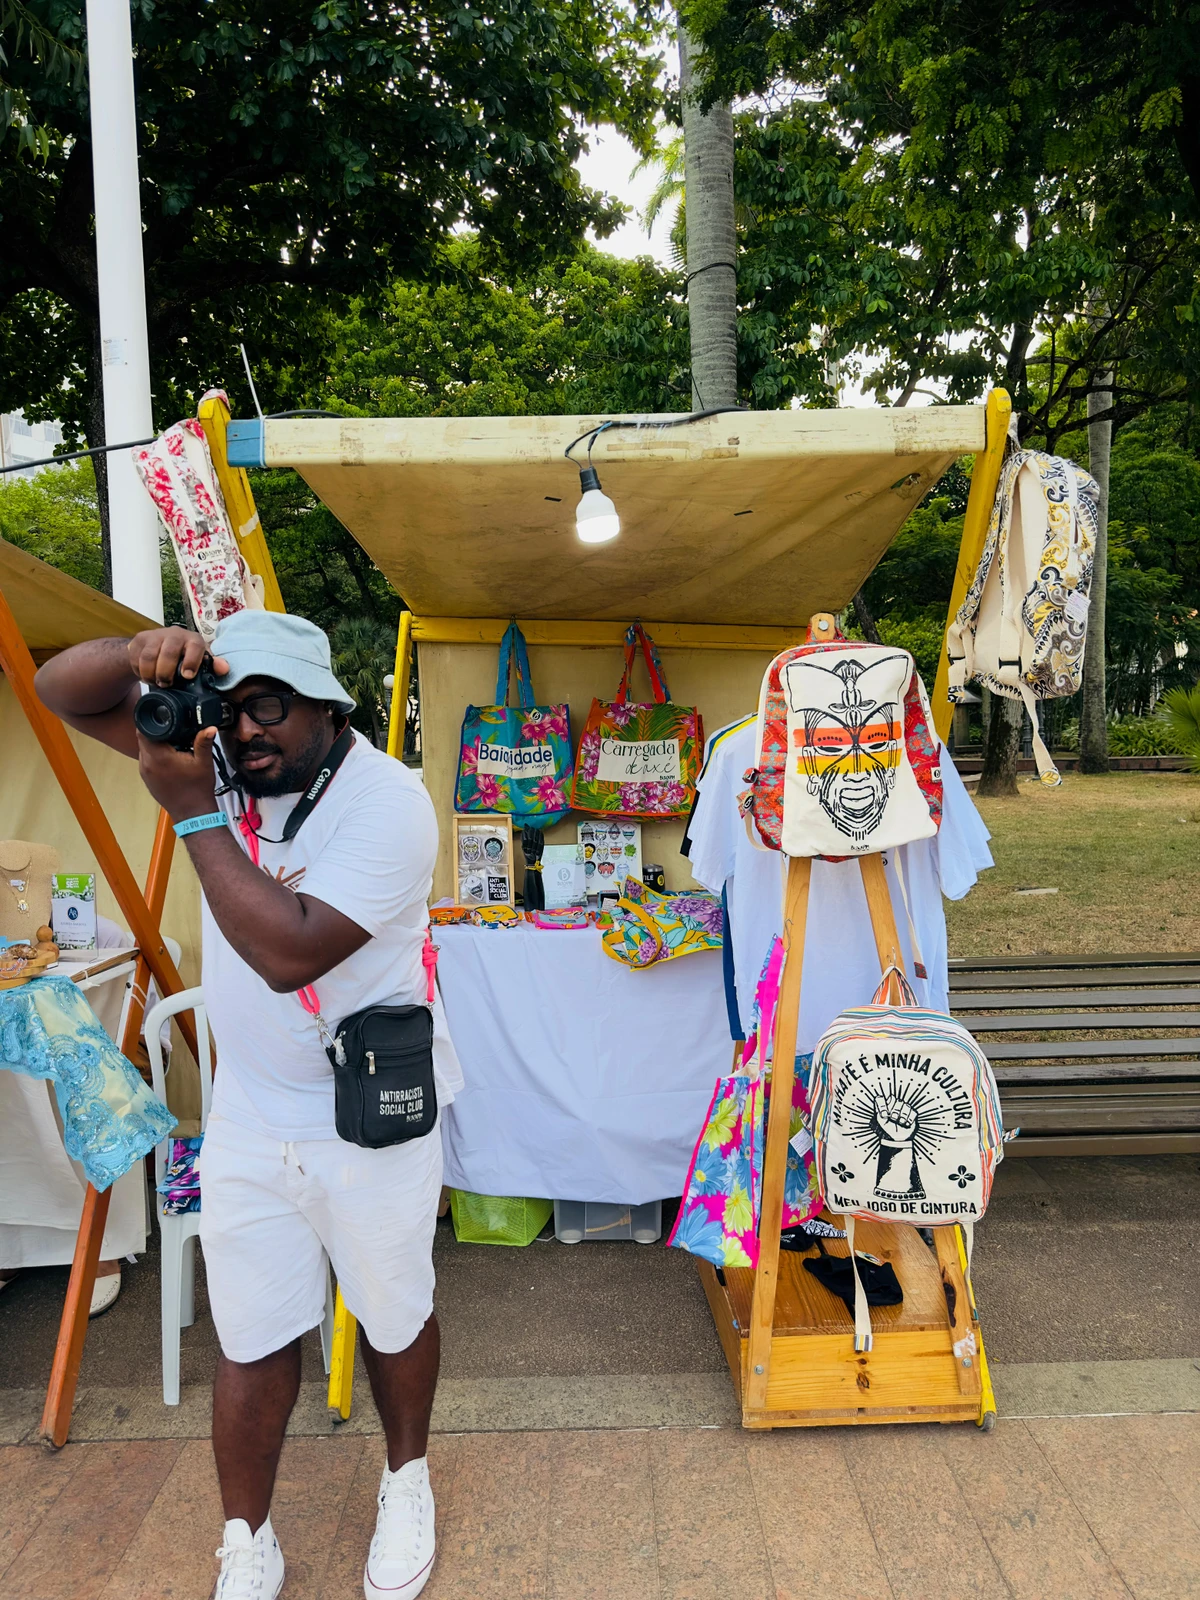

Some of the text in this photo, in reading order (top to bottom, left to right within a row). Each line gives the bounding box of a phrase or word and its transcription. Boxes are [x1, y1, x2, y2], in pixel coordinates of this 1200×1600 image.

[601, 740, 675, 761] Carregada
[307, 768, 331, 800] Canon
[200, 816, 219, 826] FEIRA
[380, 1086, 423, 1102] ANTIRRACISTA
[841, 1060, 862, 1086] FÉ
[859, 1053, 873, 1074] É
[875, 1053, 931, 1076] MINHA
[931, 1066, 973, 1130] CULTURA
[380, 1099, 424, 1115] SOCIAL CLUB
[834, 1193, 977, 1215] MEU JOGO DE CINTURA
